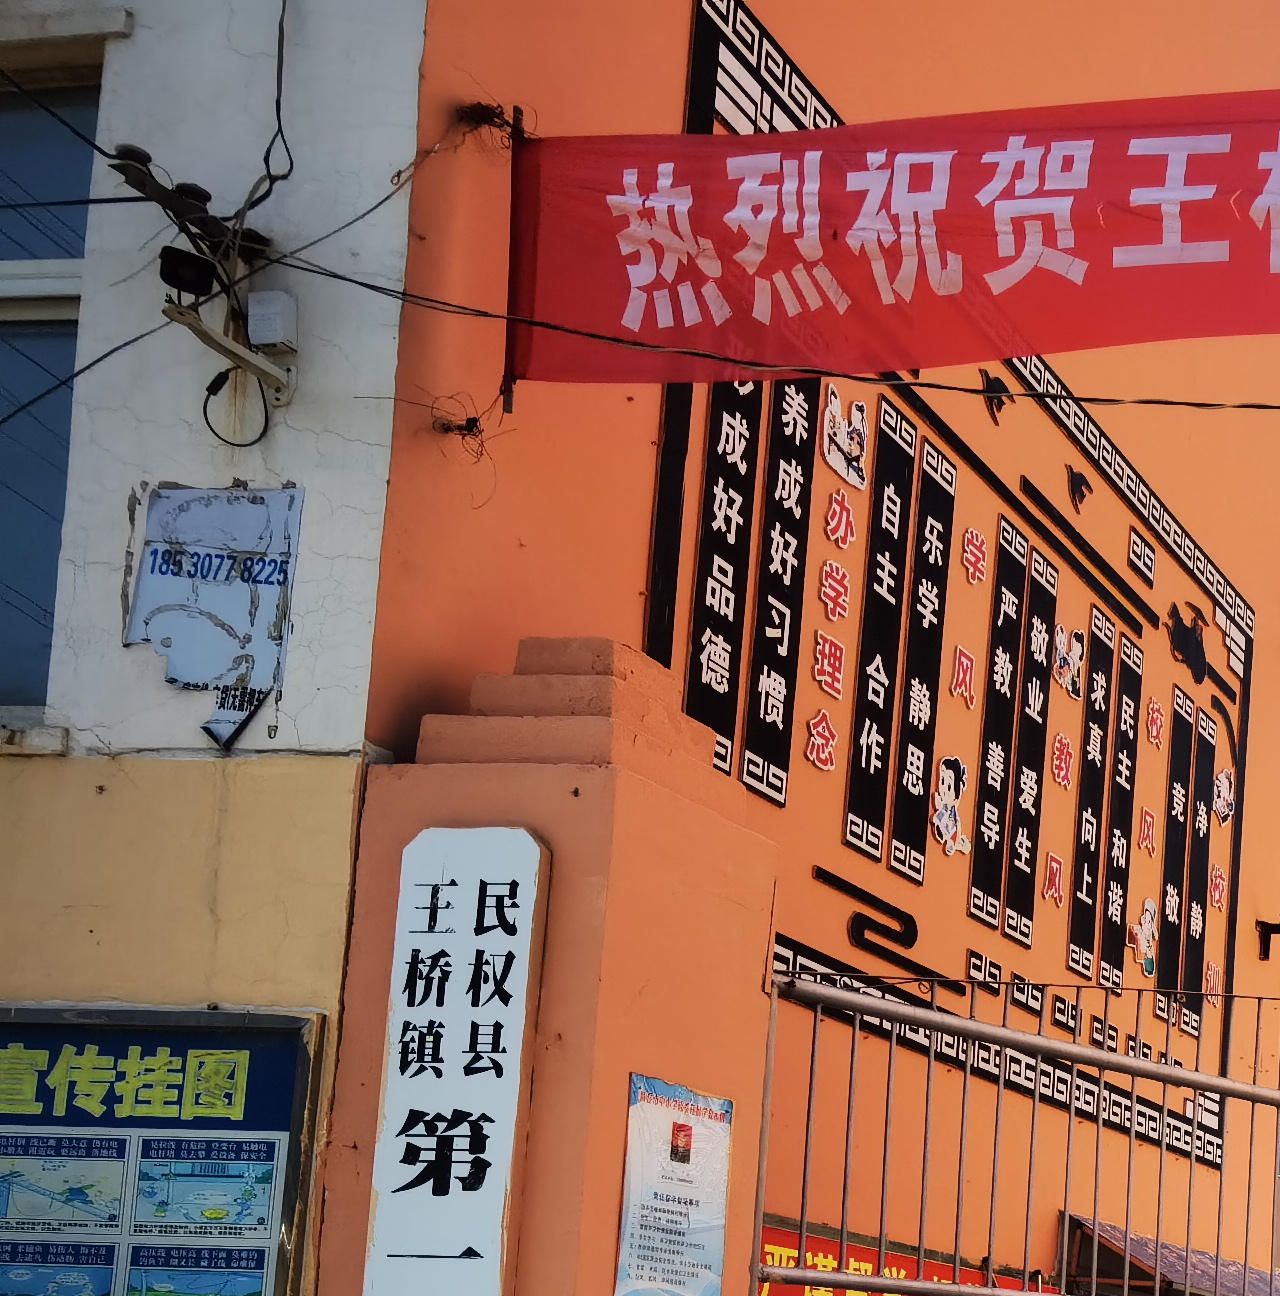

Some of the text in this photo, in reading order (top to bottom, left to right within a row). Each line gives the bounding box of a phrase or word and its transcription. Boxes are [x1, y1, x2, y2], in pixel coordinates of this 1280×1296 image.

[697, 381, 756, 696] 成好品德
[756, 384, 810, 731] 养成好习惯
[806, 489, 857, 771] 办学理念
[951, 527, 989, 710] 学风
[1044, 732, 1073, 908] 教风
[398, 878, 456, 1080] 王桥镇
[461, 878, 520, 1079] 民权县
[0, 1043, 250, 1120] 宣传挂图
